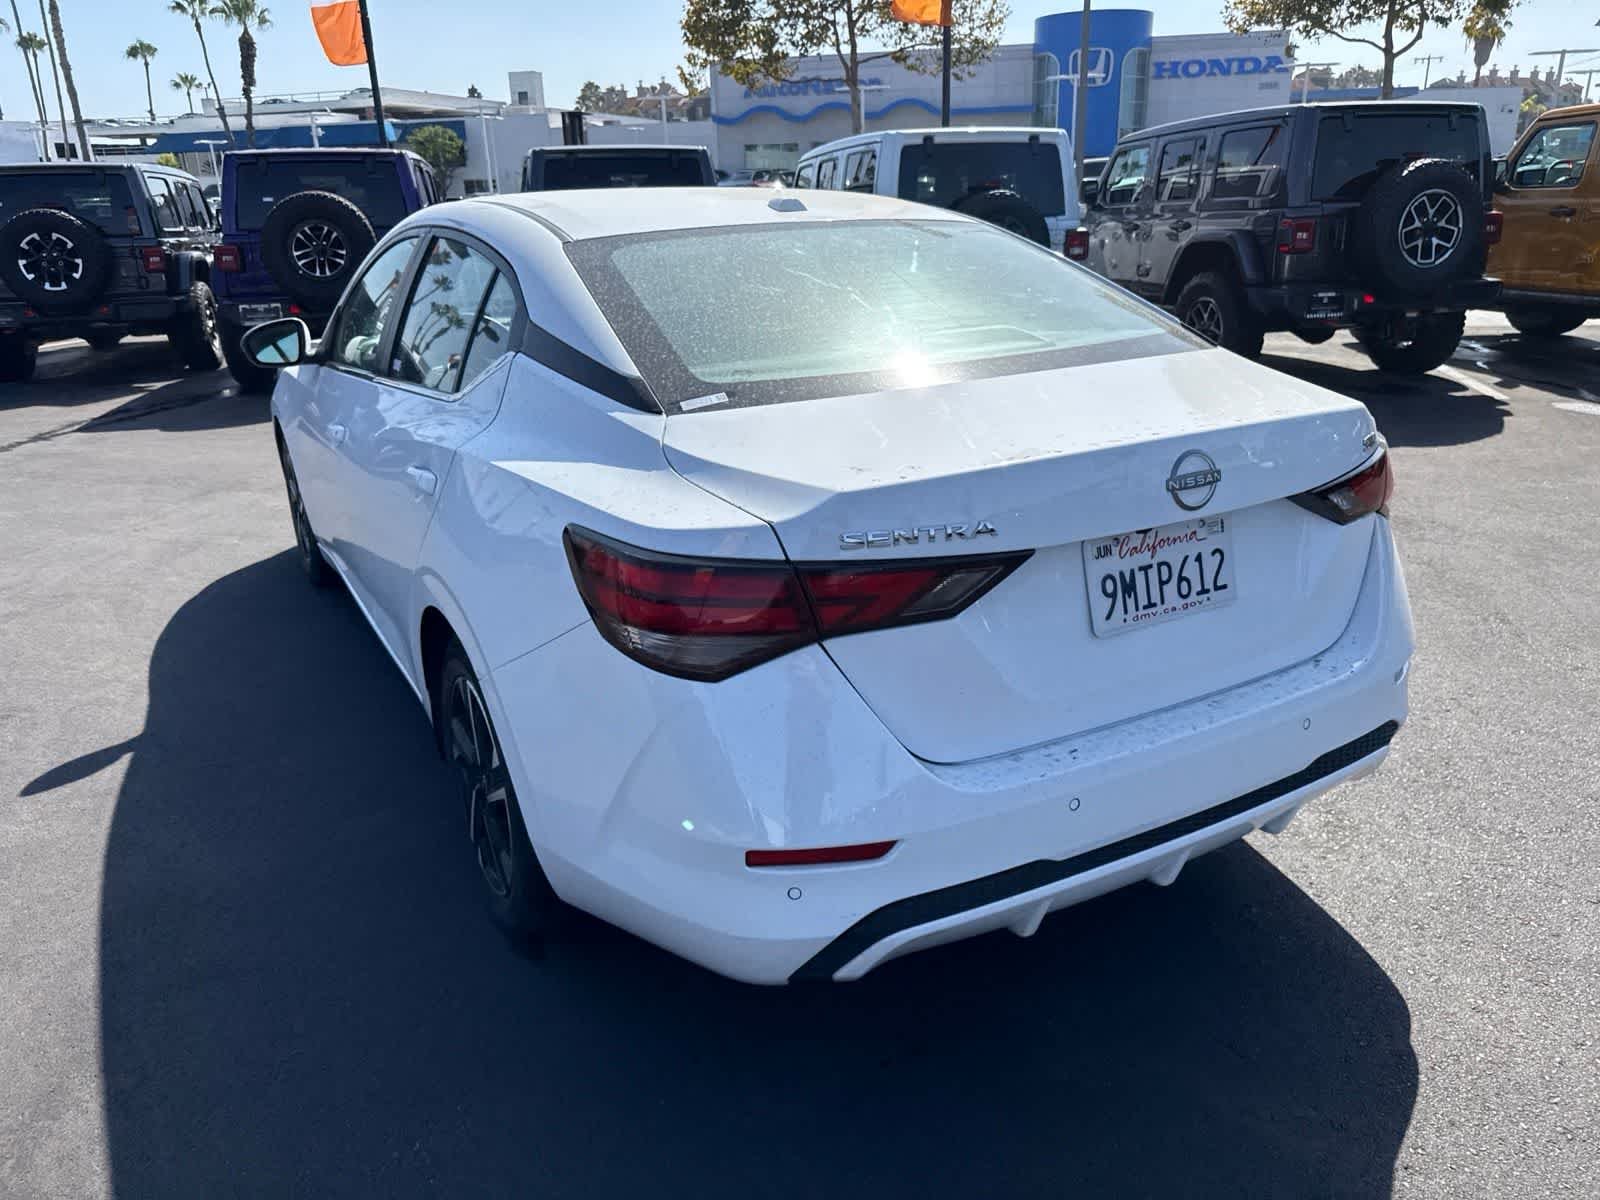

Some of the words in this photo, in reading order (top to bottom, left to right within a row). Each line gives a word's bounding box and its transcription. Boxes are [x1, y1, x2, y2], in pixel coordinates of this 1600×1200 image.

[1153, 55, 1289, 79] HONDA
[1168, 471, 1221, 490] NISSAN
[839, 520, 998, 550] SENTRA
[1118, 529, 1207, 560] California
[1094, 543, 1113, 560] JUN
[1101, 547, 1228, 622] 9MIP612
[1132, 599, 1204, 623] dmv.ca.gov
